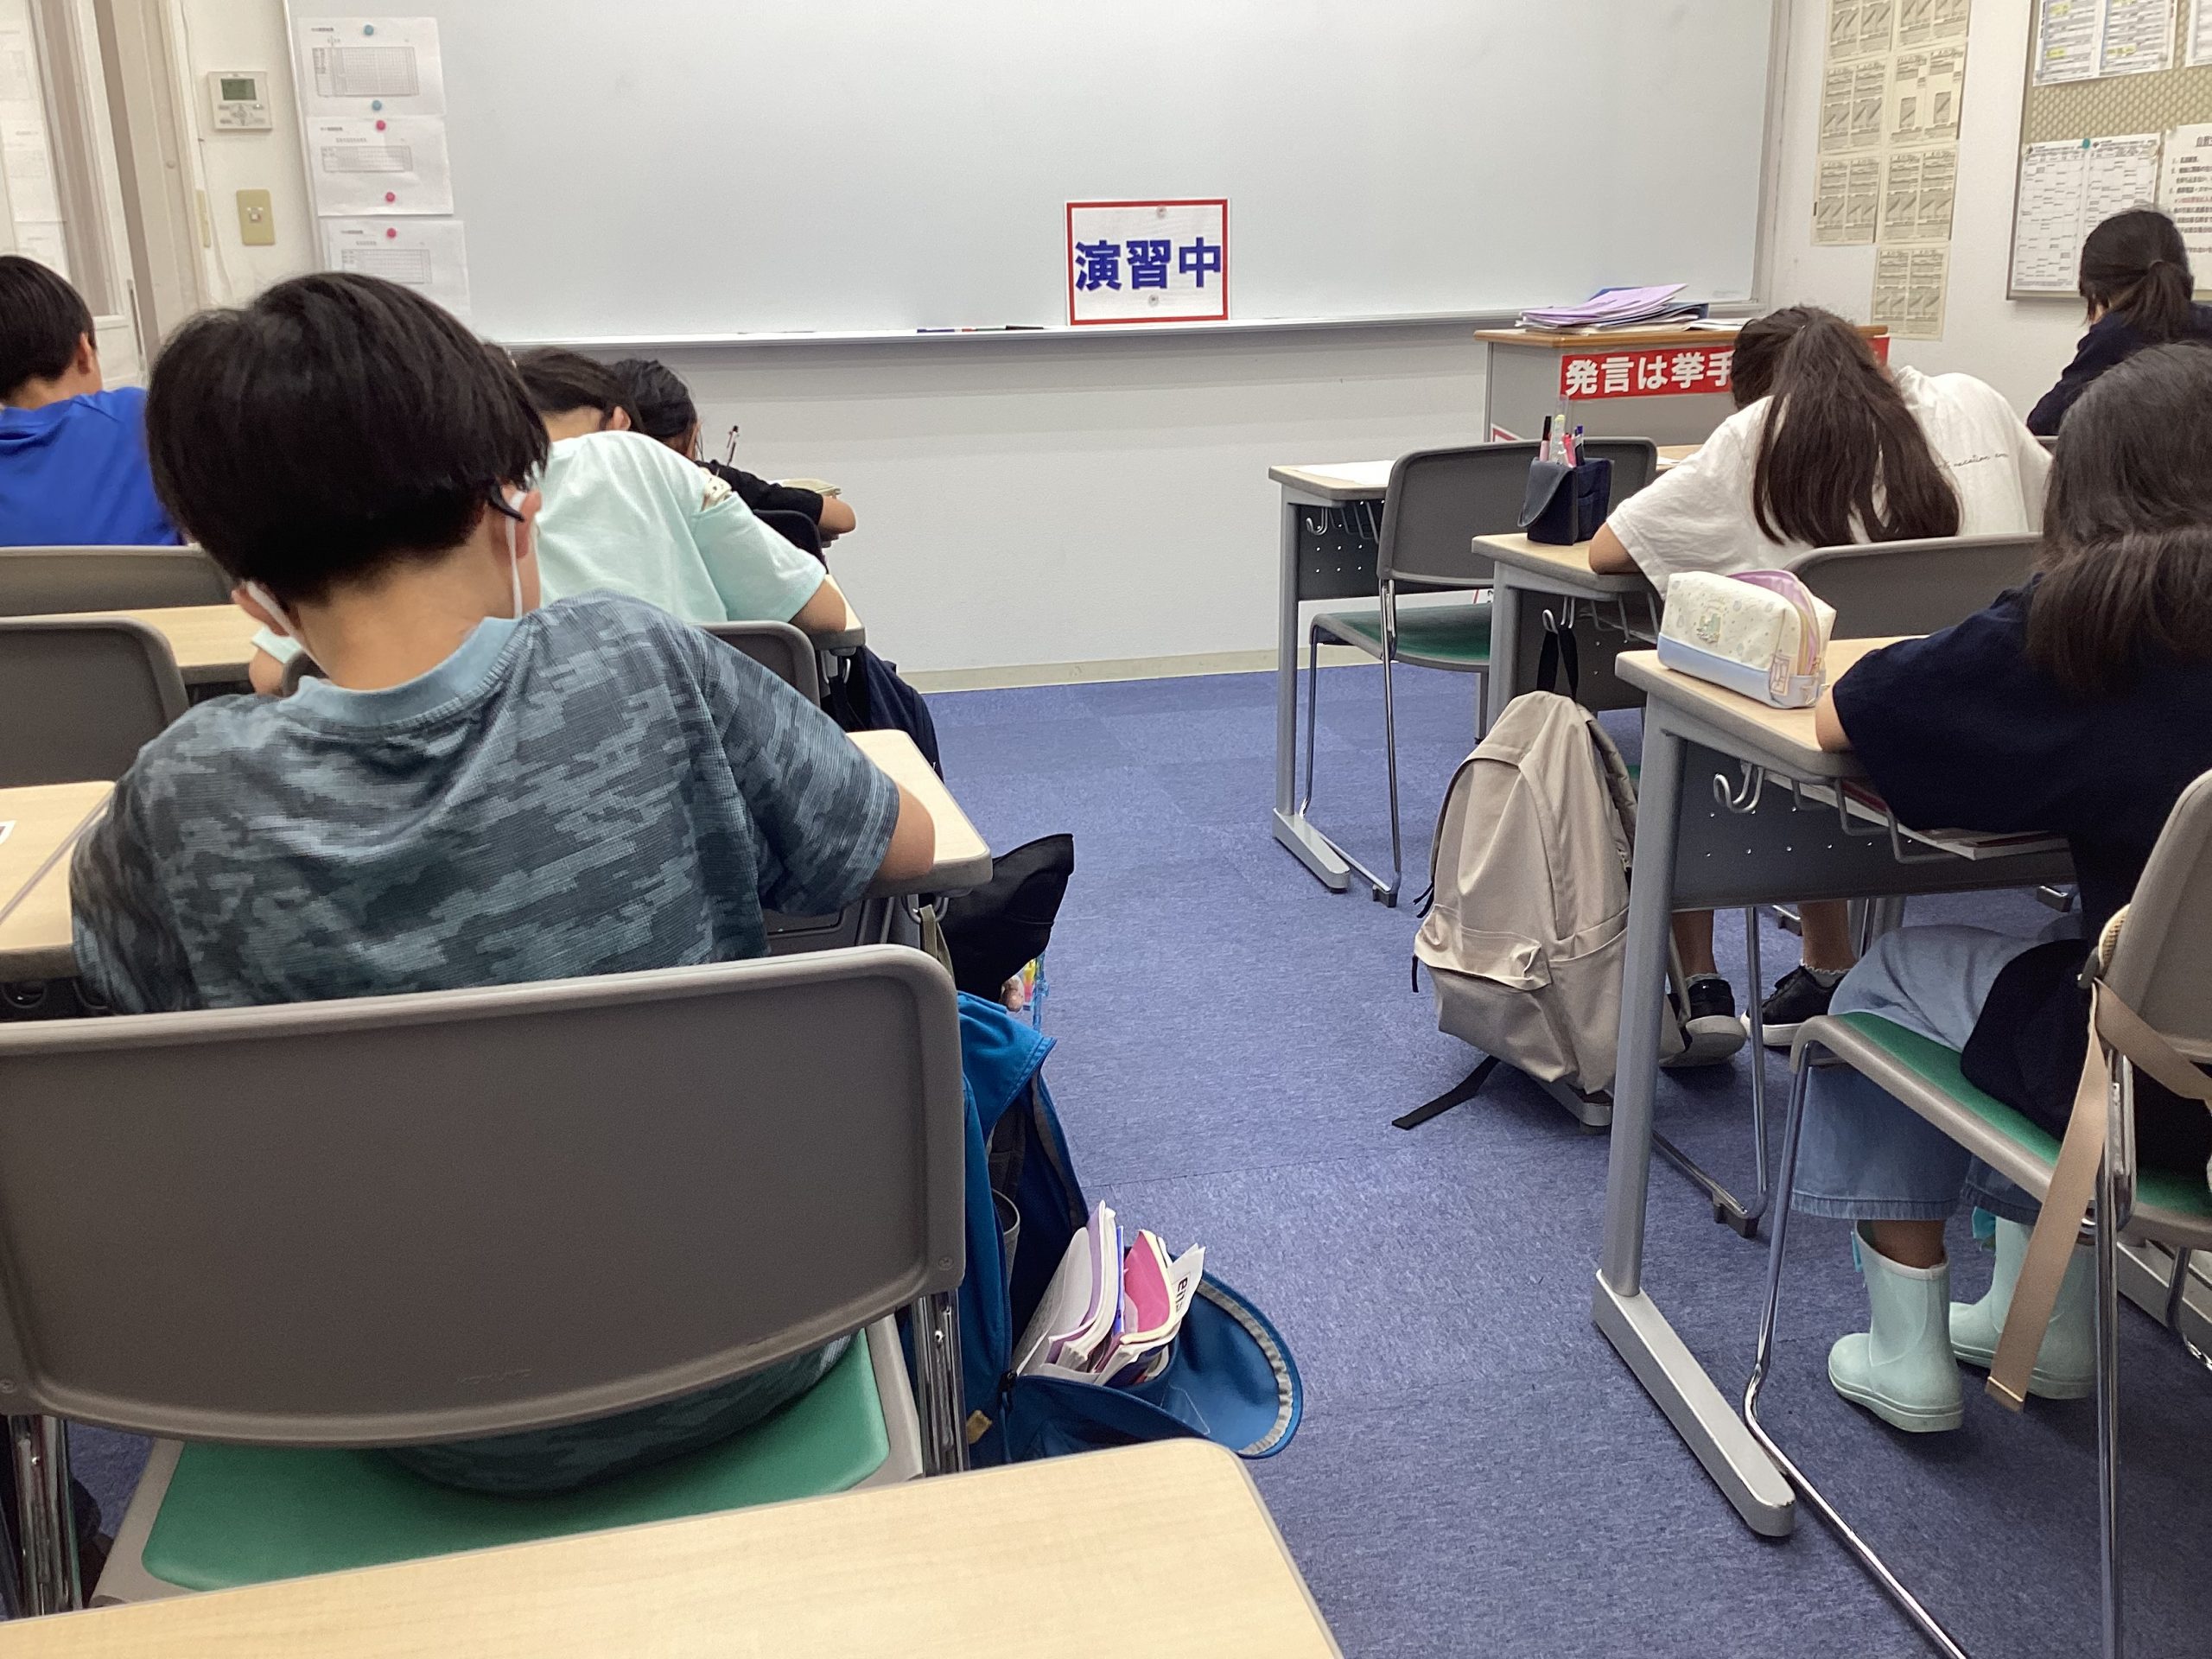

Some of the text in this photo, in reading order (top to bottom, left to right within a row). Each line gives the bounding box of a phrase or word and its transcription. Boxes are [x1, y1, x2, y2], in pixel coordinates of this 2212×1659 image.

[1075, 237, 1222, 291] 演習中
[1565, 349, 1736, 397] 発言は挙手
